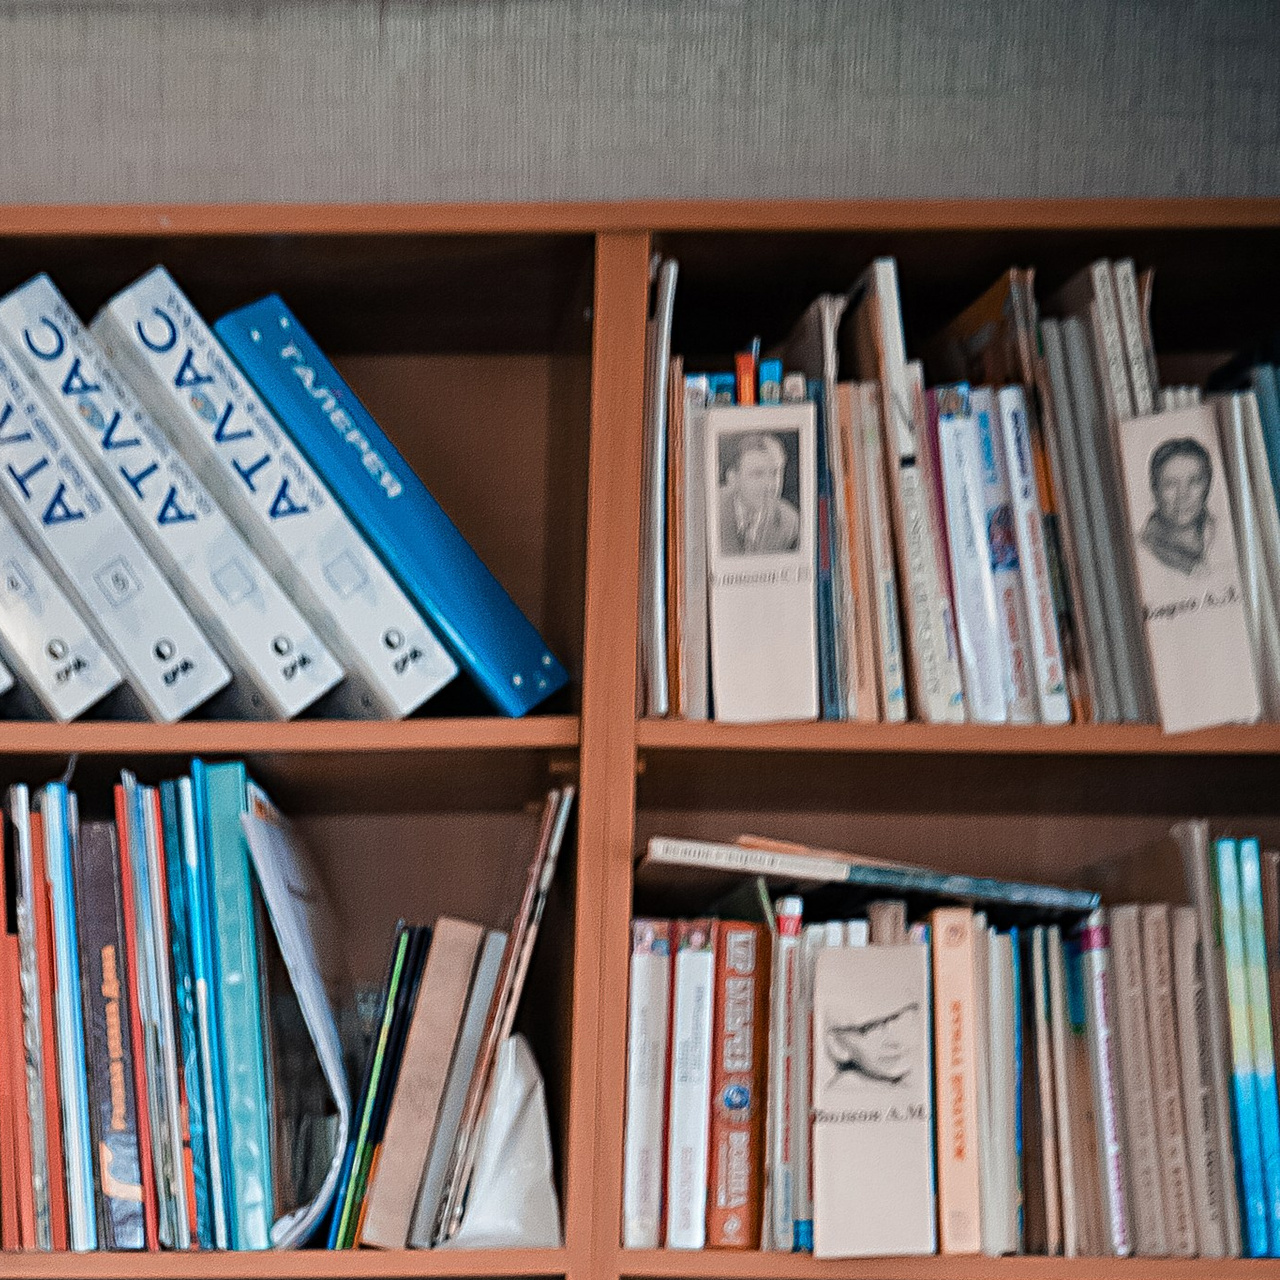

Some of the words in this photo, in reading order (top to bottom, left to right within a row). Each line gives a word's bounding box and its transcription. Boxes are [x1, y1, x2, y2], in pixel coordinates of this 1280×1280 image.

[23, 311, 198, 528] АТЛАС
[135, 303, 308, 522] АТЛАС
[278, 339, 401, 500] ГАЛЕРЕЯ
